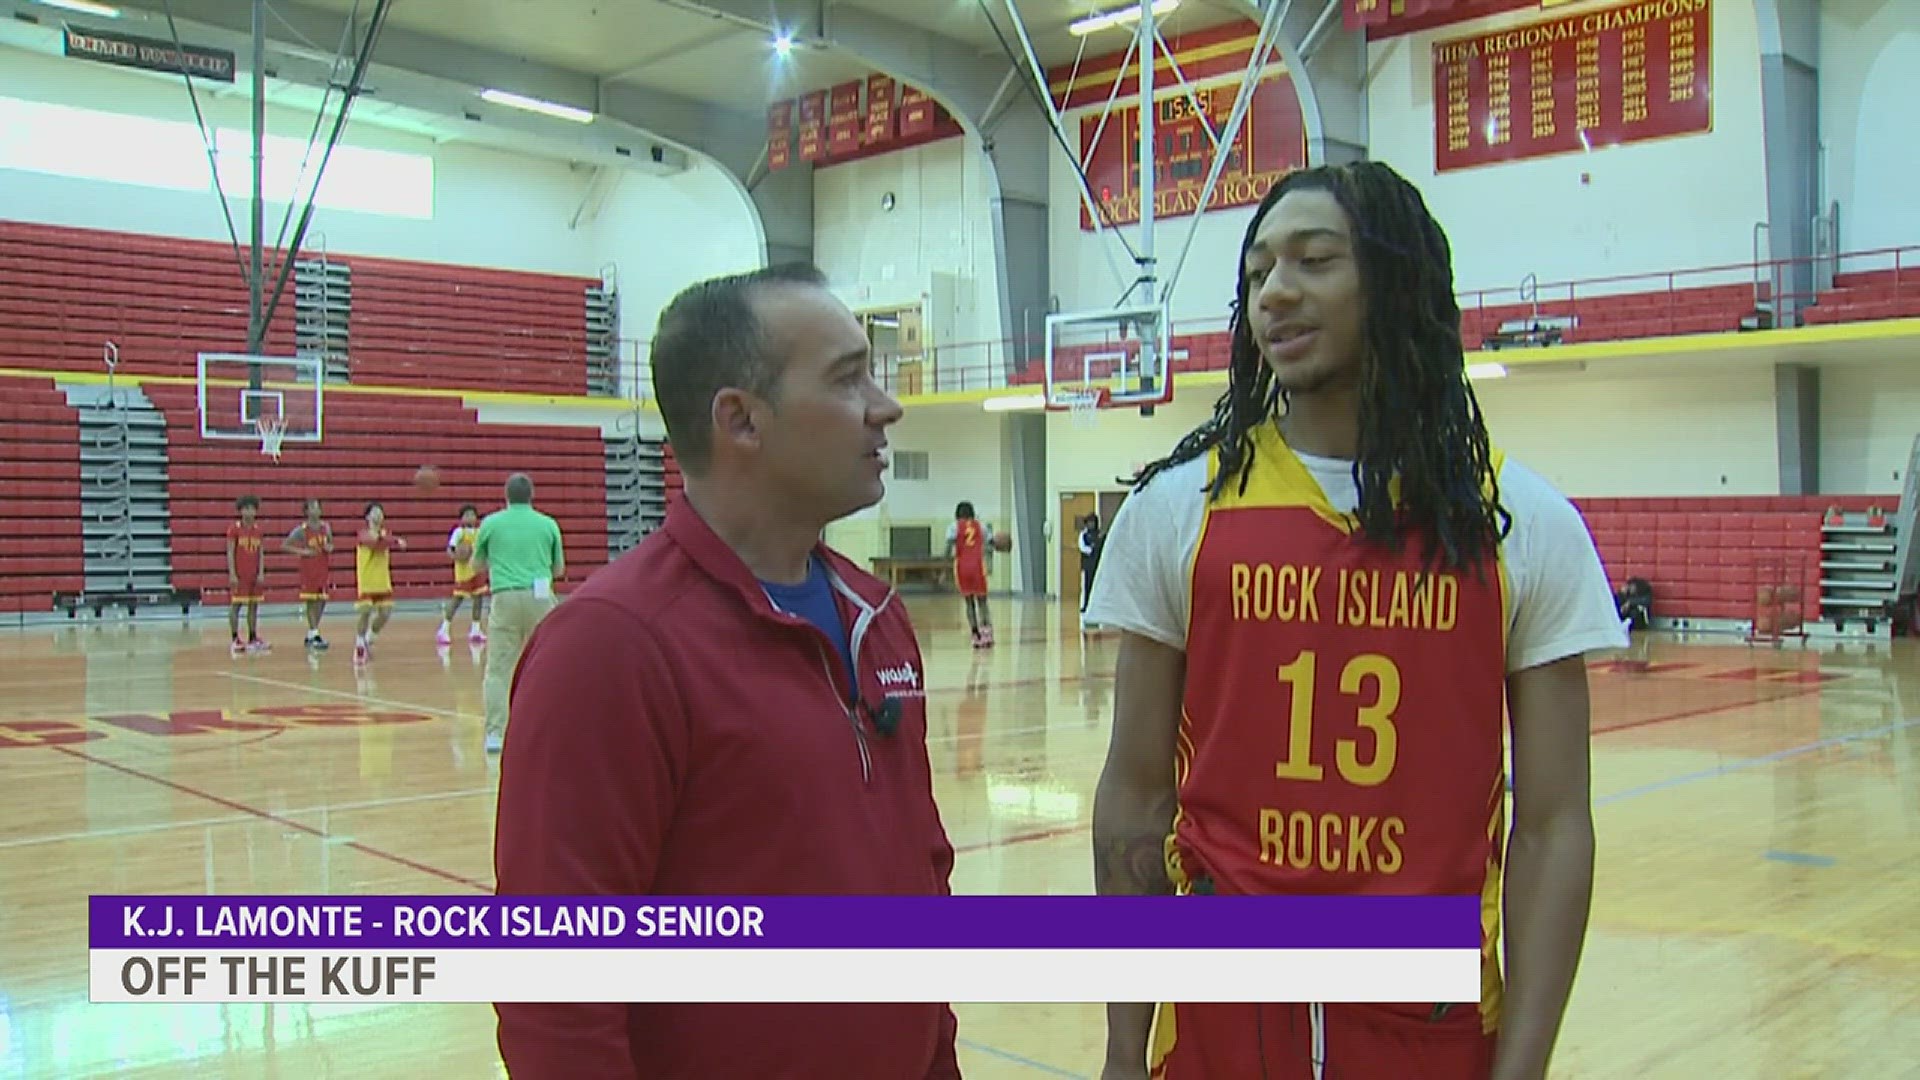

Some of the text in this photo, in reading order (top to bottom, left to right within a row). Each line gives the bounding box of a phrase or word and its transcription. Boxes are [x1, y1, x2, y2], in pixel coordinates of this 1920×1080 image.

[1440, 0, 1706, 64] IHSA REGIONAL CHAMPIONS
[965, 526, 976, 547] 2
[1231, 563, 1459, 631] ROCK ISLAND
[1276, 650, 1401, 786] 13
[1259, 808, 1404, 873] ROCKS
